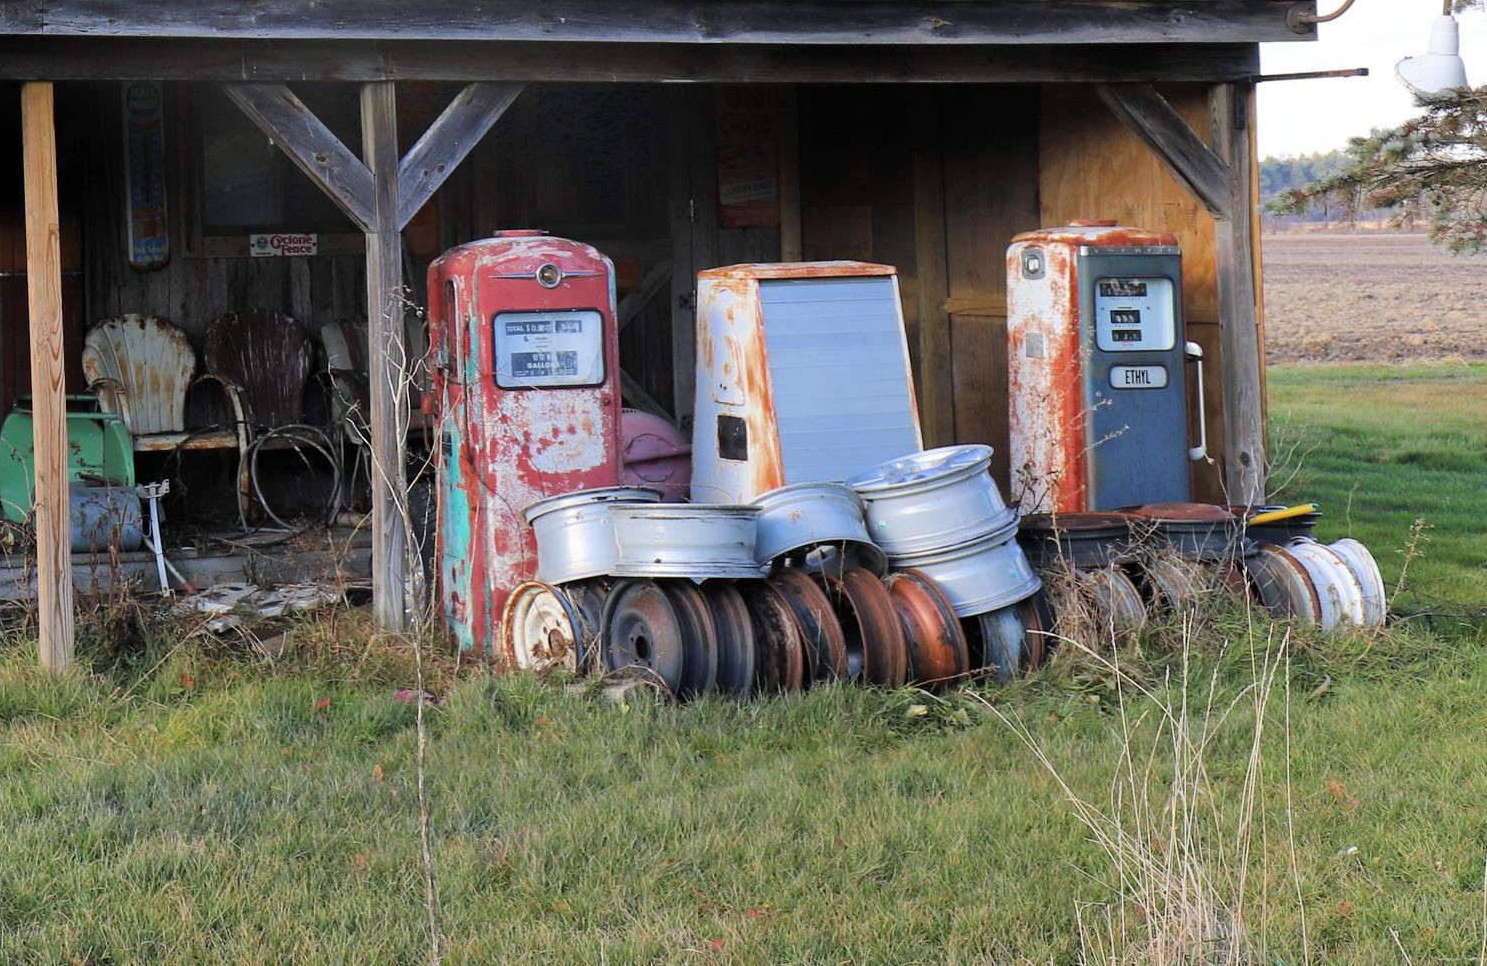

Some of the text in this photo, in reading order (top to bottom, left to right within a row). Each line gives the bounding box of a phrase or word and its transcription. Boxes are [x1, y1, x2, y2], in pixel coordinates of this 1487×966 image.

[270, 234, 312, 249] Cyclone
[281, 244, 312, 257] Fence
[1125, 369, 1151, 384] ETHYL
